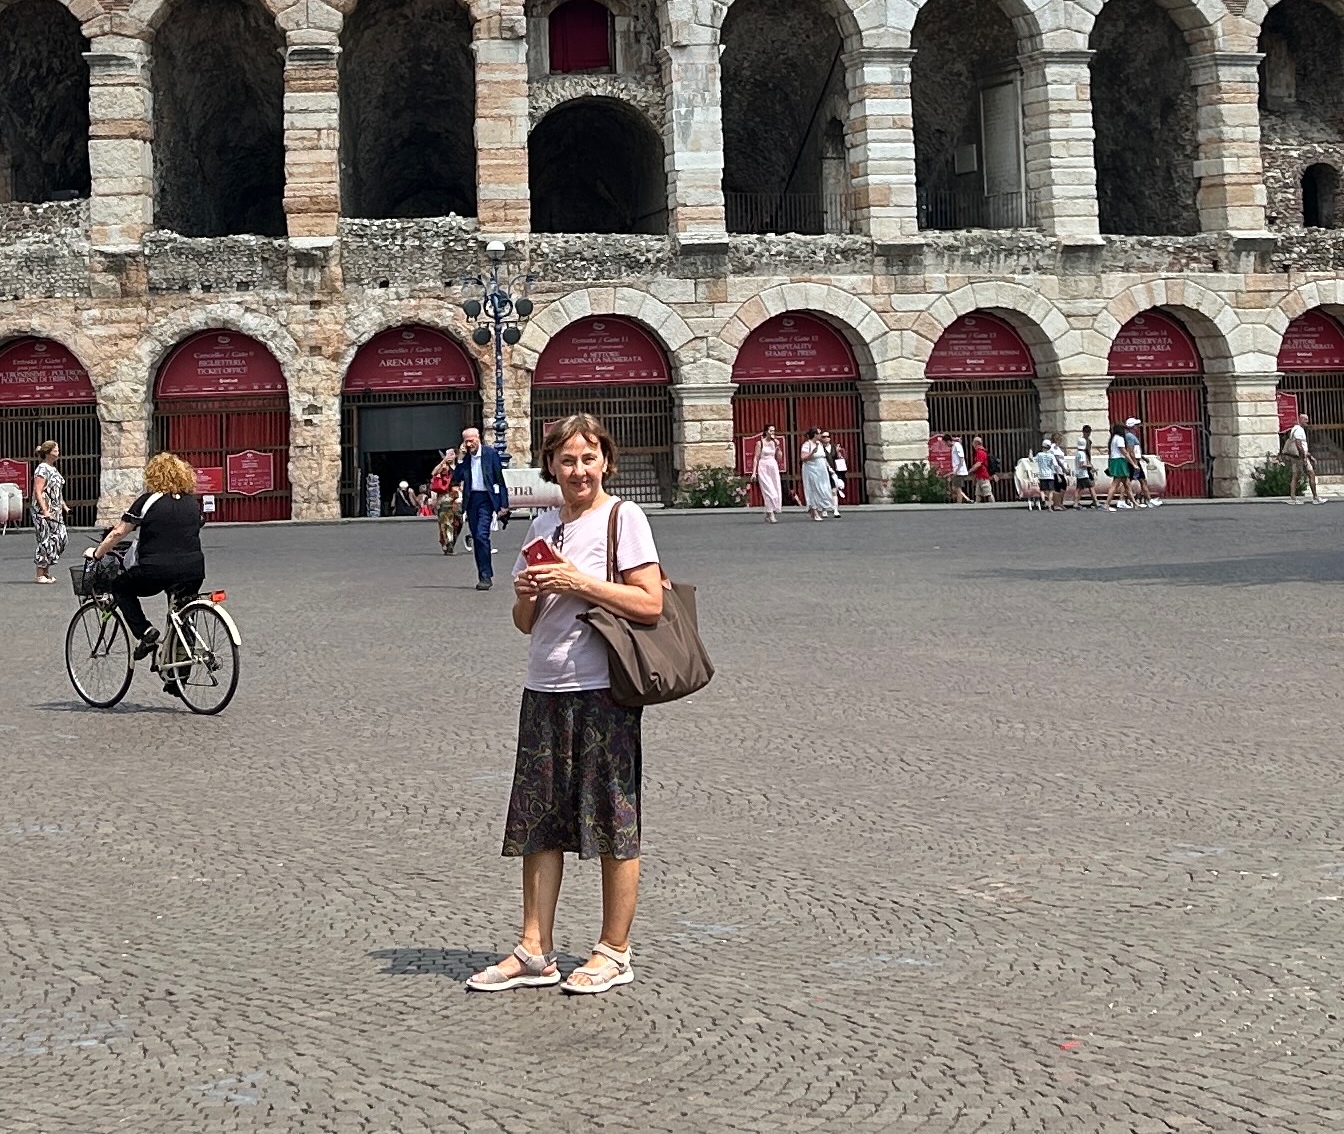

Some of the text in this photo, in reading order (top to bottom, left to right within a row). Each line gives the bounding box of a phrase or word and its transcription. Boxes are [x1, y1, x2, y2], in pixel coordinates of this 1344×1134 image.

[379, 357, 442, 367] ARENA SHOP
[508, 486, 534, 496] ena
